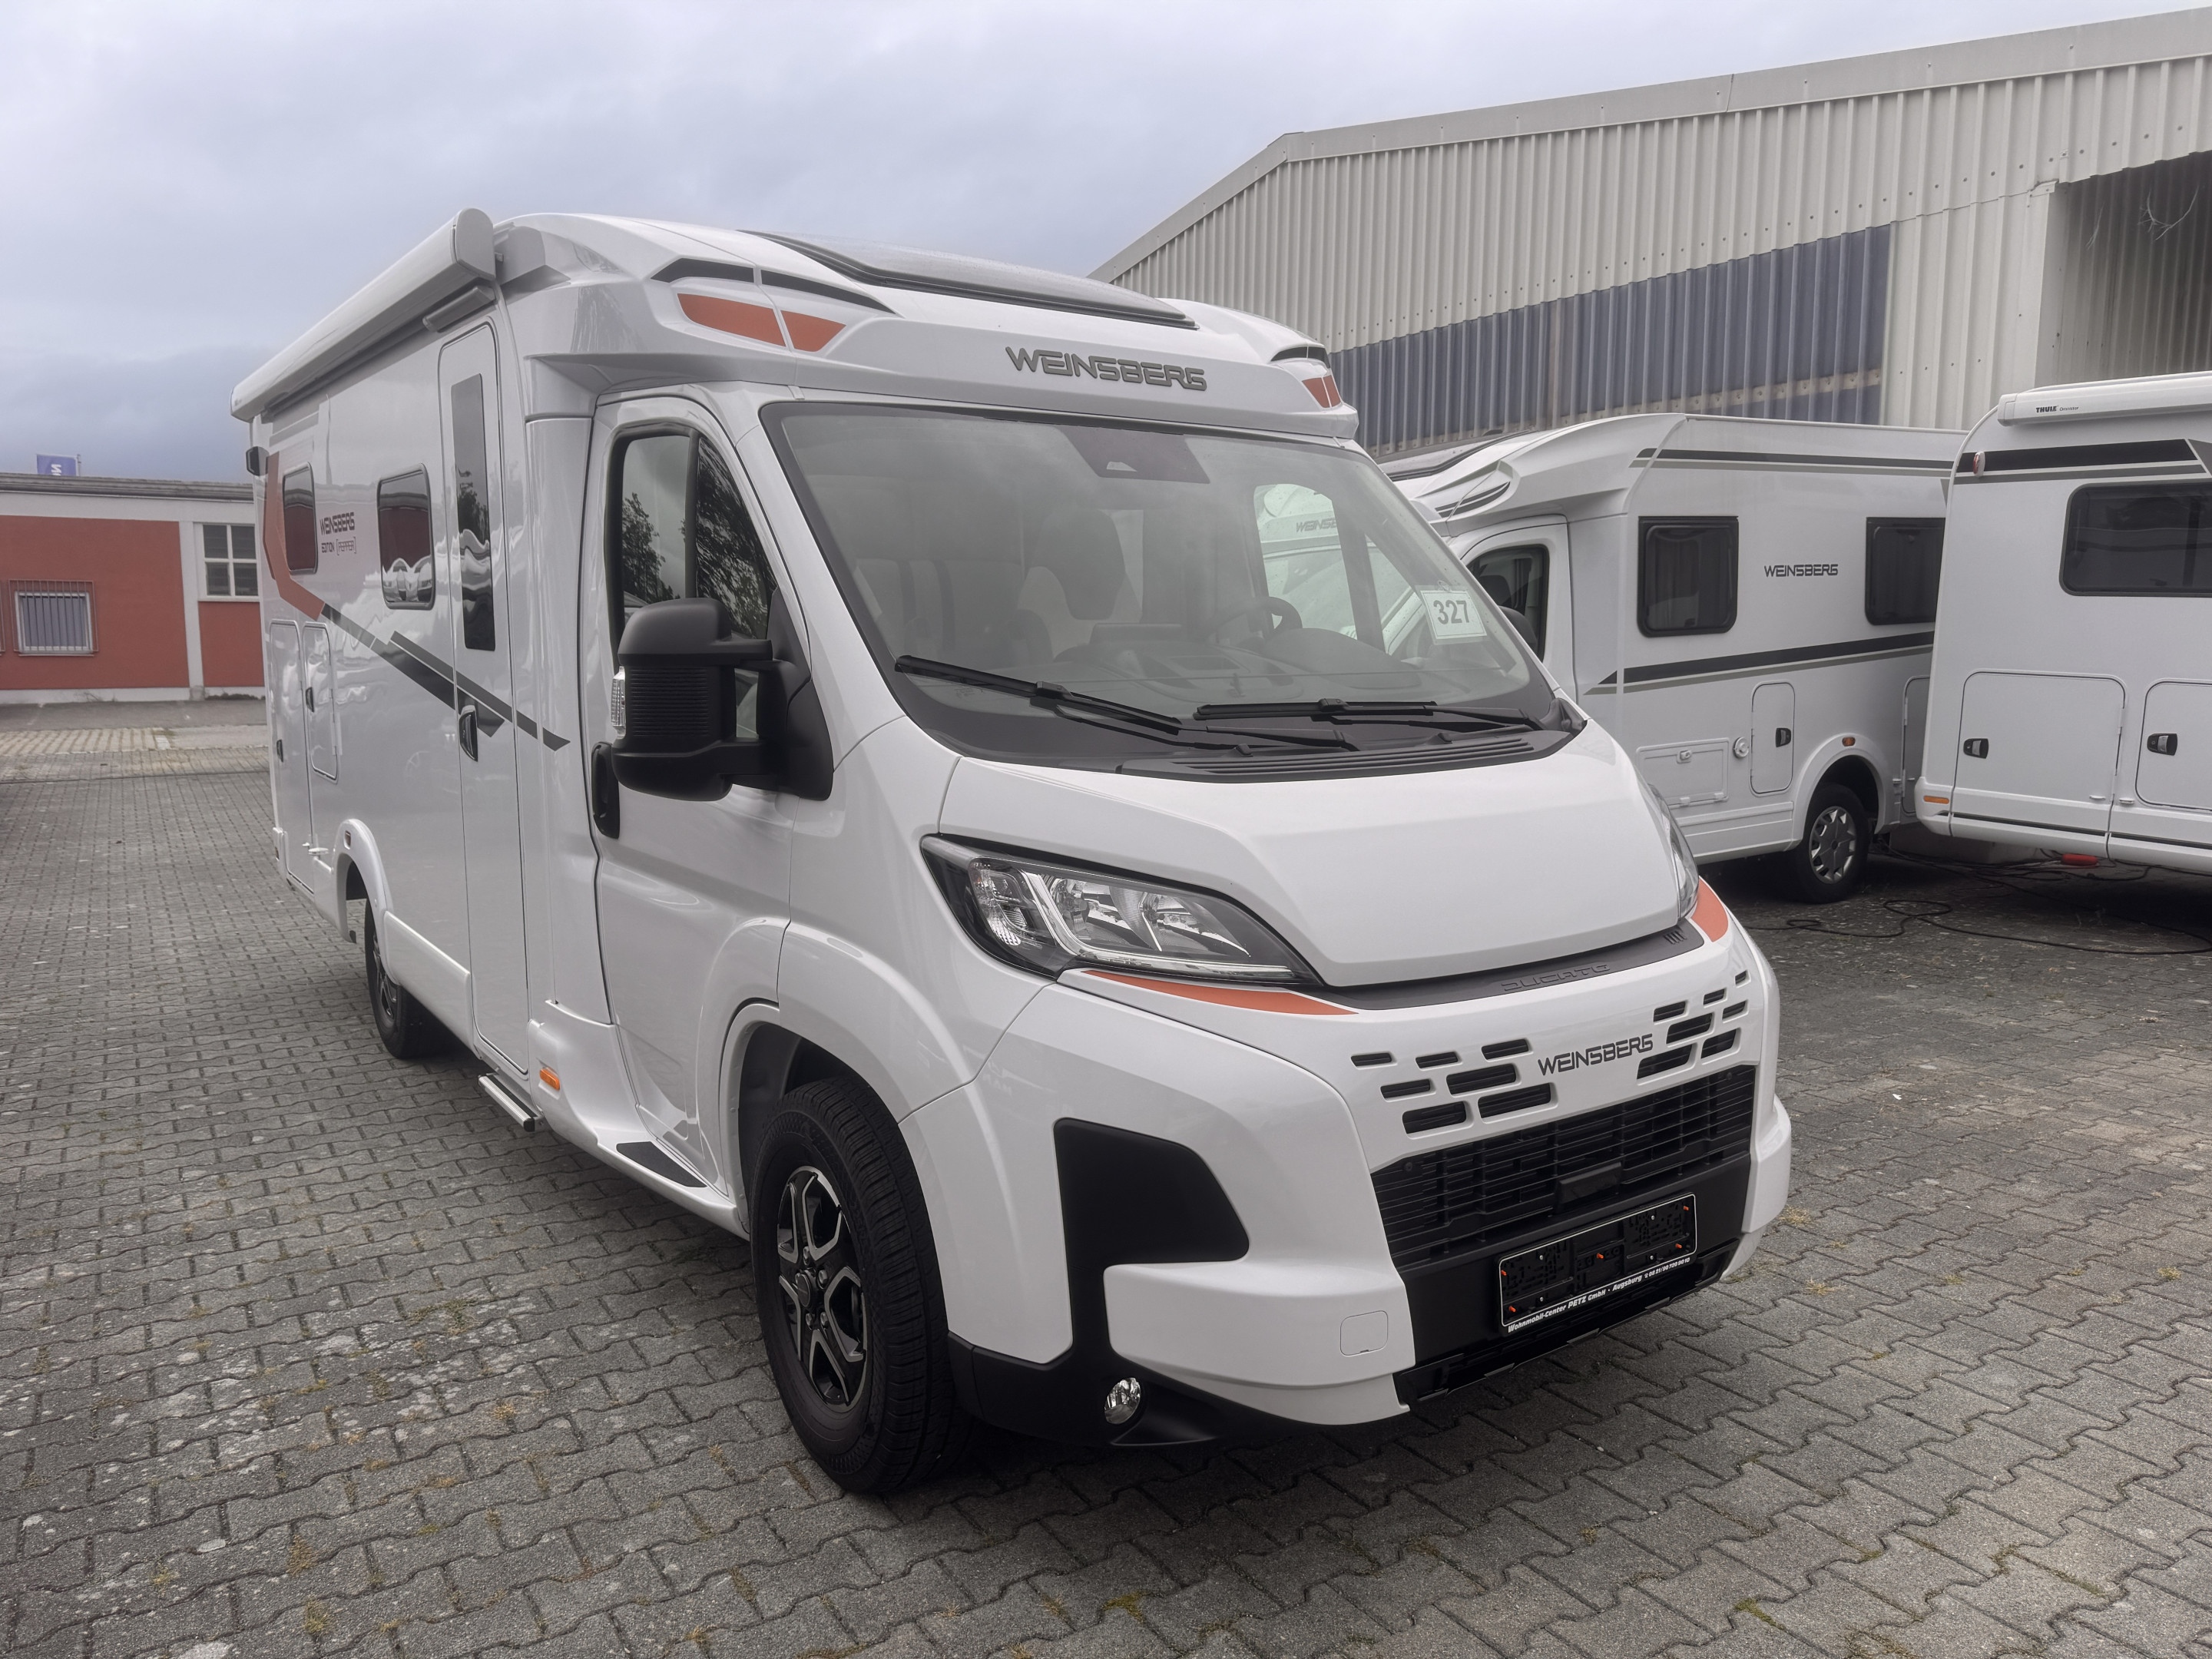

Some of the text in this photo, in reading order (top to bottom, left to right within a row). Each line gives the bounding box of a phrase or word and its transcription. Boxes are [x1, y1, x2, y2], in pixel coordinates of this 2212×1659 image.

[1005, 346, 1207, 391] WEINSBERG
[320, 512, 355, 535] WEINSBERG
[1763, 564, 1839, 578] WEINSBERG
[1433, 600, 1470, 625] 327
[1501, 964, 1611, 992] DUCATO
[1538, 1033, 1653, 1076] WEINSBERG
[1568, 1296, 1587, 1309] PETZ
[1612, 1274, 1643, 1292] Augsburg
